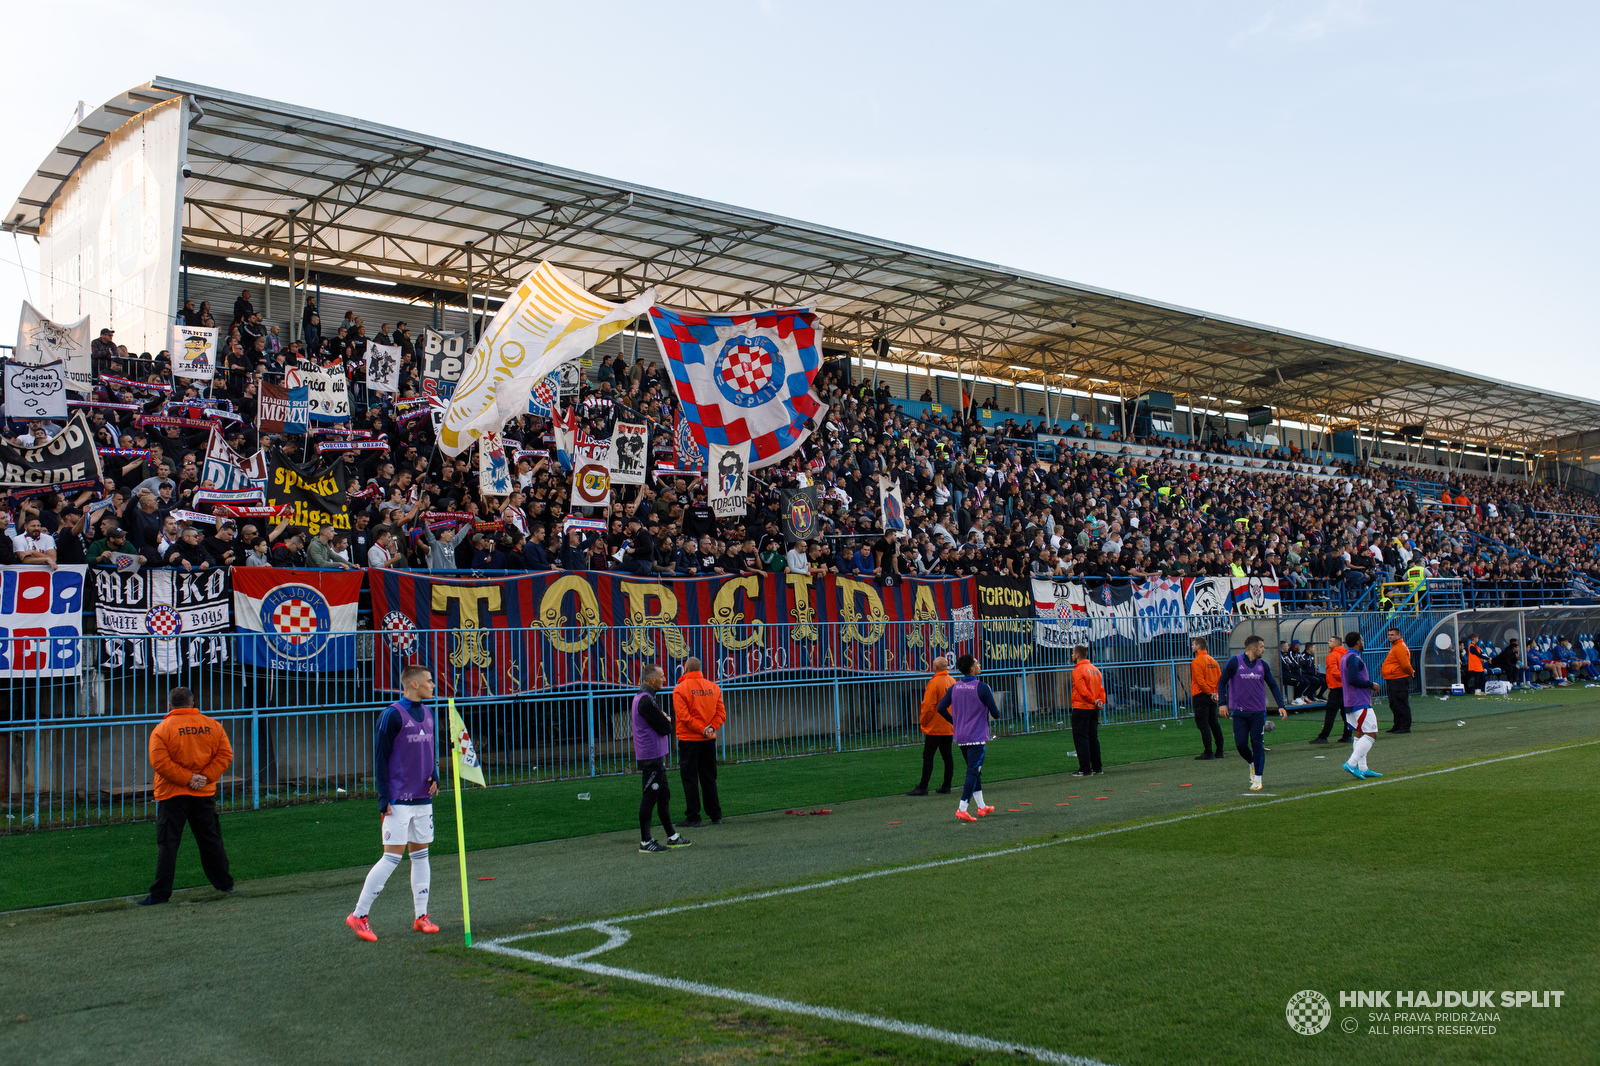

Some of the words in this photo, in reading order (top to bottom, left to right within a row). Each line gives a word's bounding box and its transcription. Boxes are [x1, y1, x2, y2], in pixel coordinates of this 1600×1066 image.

[181, 329, 213, 337] WANTED
[21, 381, 39, 389] Split
[40, 381, 58, 389] 24/7
[734, 381, 777, 407] SPLIT
[292, 400, 308, 408] SPLIT
[144, 416, 182, 425] TORCIDA
[260, 402, 308, 424] MCMXI
[617, 424, 647, 436] STOP
[0, 461, 86, 484] RCIDE
[575, 472, 611, 490] 1950
[12, 485, 53, 500] WHITE
[269, 587, 323, 609] HAJDUK
[978, 585, 1032, 608] TORCIDA
[147, 604, 178, 618] HAJDUK
[102, 612, 139, 630] WHITE
[190, 608, 223, 628] BOYS
[431, 573, 949, 668] TORCIDA
[691, 688, 714, 697] REDAR
[178, 726, 211, 736] REDAR
